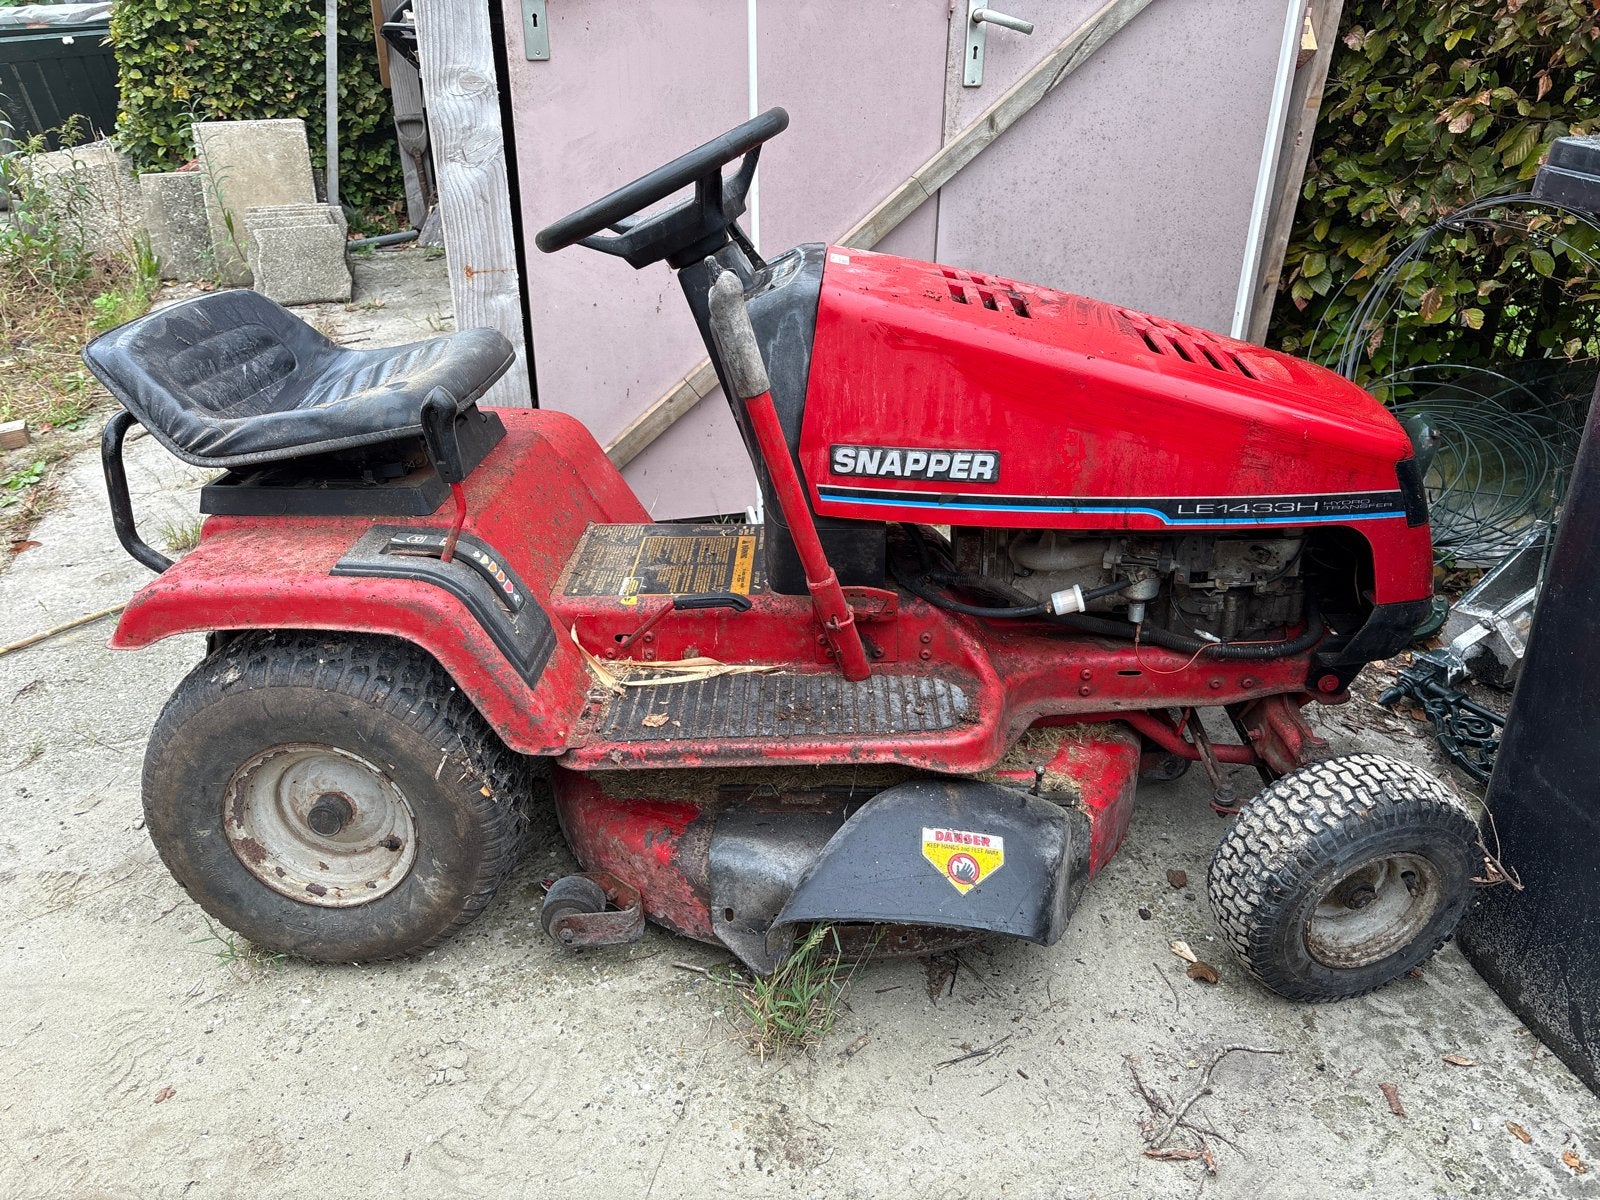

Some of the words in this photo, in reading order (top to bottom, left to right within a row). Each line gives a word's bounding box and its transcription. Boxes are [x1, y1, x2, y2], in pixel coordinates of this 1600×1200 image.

[834, 447, 995, 480] SNAPPER
[1178, 501, 1319, 514] LE1433H
[1324, 502, 1393, 510] TRANSFER
[935, 830, 991, 847] DANGER
[941, 843, 960, 851] HANDS
